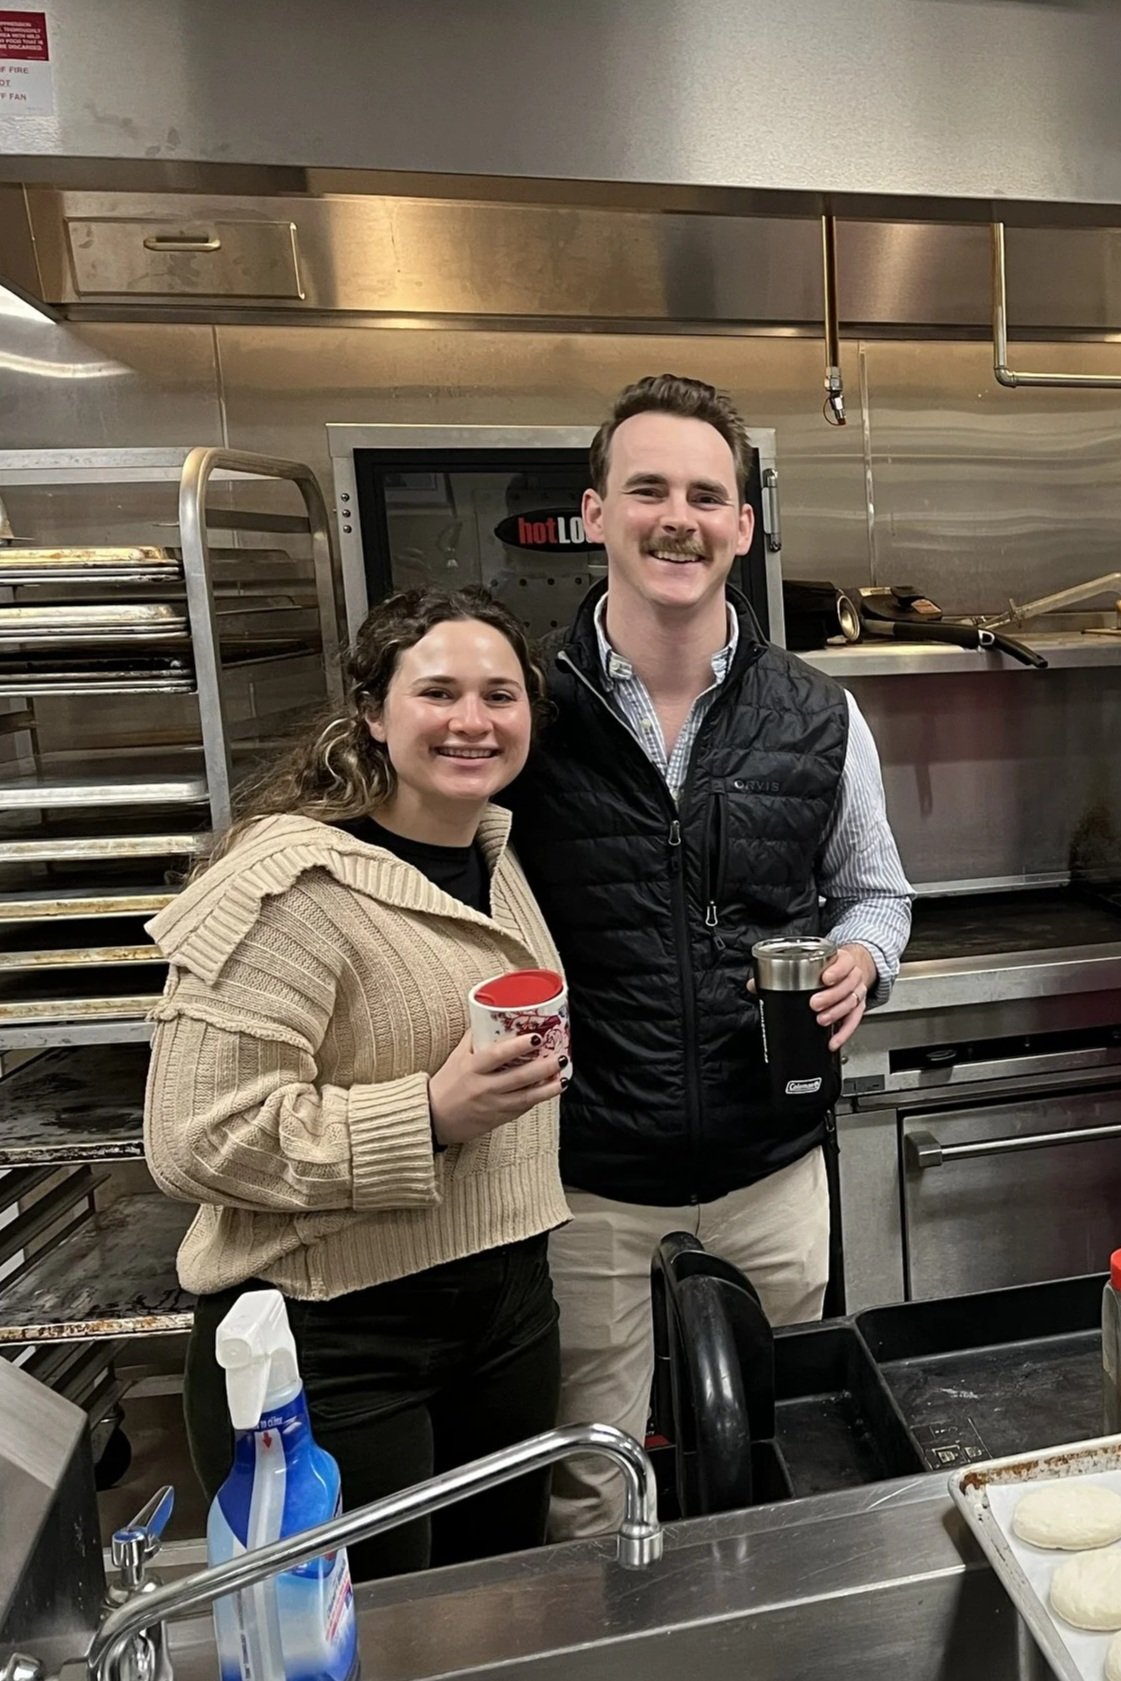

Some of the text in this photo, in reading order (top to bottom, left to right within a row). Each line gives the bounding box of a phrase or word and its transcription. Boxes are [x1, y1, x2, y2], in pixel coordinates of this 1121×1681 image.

[9, 66, 29, 74] FIRE
[9, 93, 27, 101] FAN
[517, 516, 592, 545] hotLO
[734, 779, 780, 792] ORVIS
